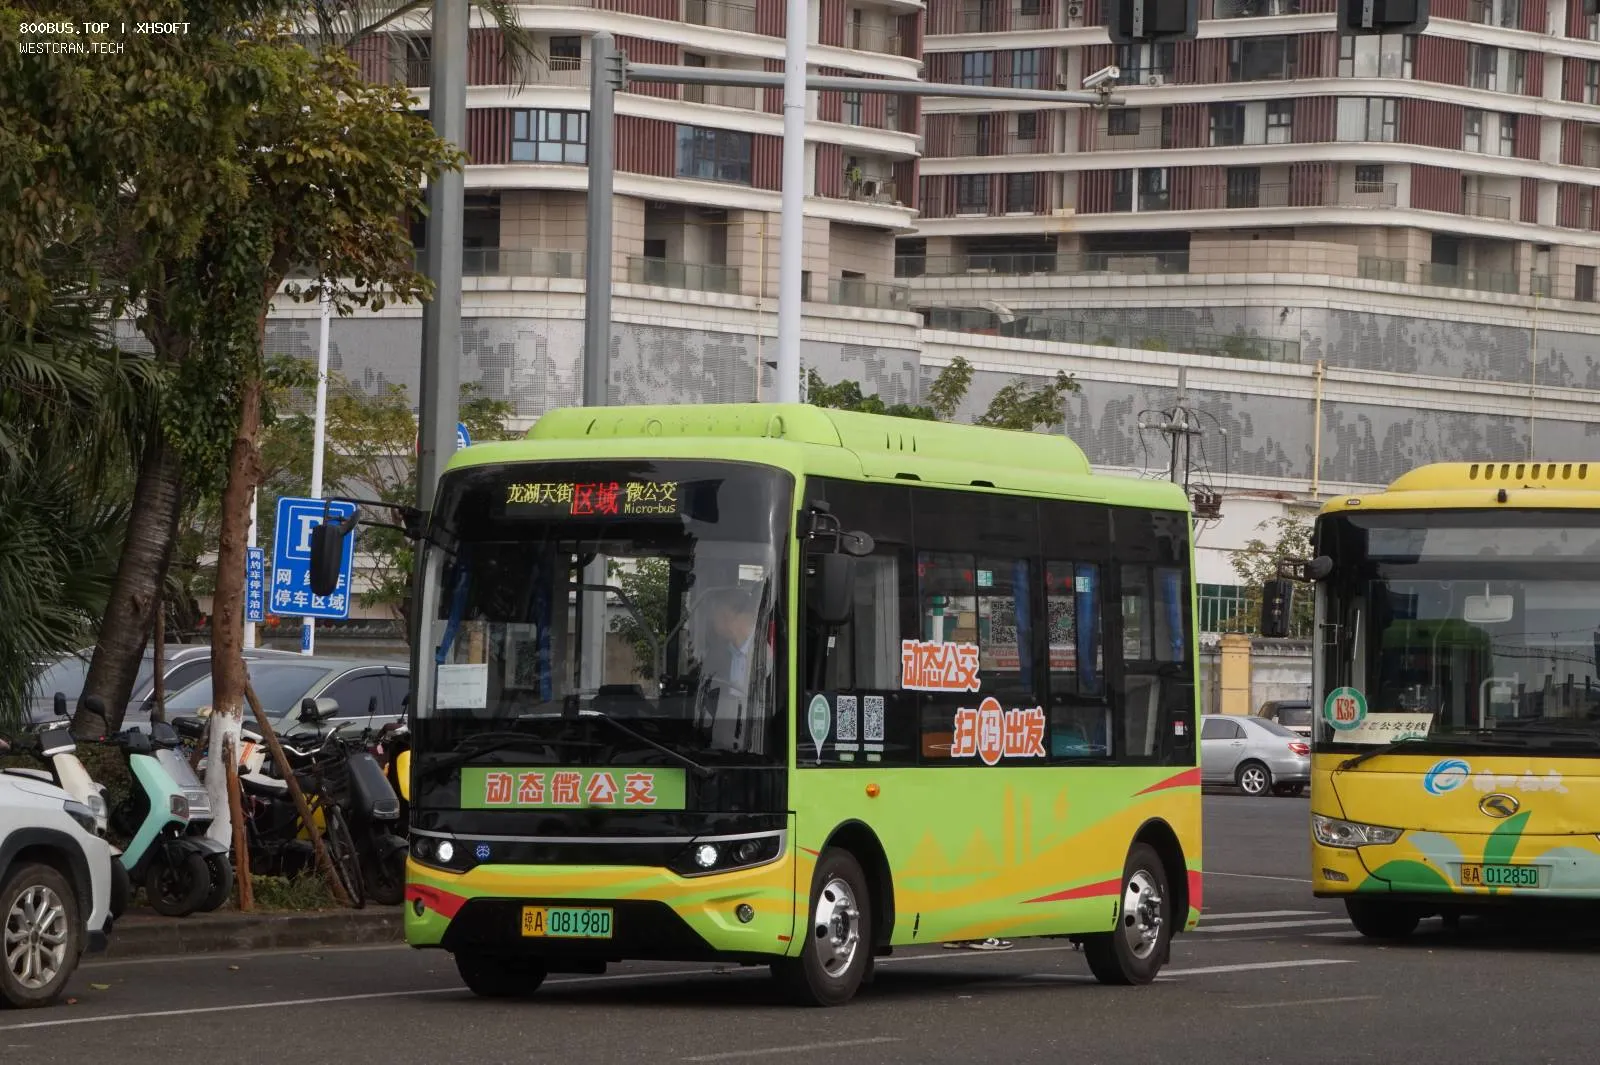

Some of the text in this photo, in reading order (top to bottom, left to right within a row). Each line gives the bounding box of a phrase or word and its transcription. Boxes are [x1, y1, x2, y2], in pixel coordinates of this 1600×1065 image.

[506, 481, 678, 515] 龙湖天街 区域 微公交
[624, 503, 676, 514] Micro-bus
[249, 550, 262, 619] 网约车停车泊位
[274, 589, 345, 611] 停车区域
[902, 640, 980, 691] 动态公交
[1336, 698, 1356, 721] K35
[951, 700, 1046, 763] 扫码出发
[485, 771, 657, 805] 动态微公交
[1486, 867, 1537, 885] 01285D
[551, 911, 610, 934] 08198D
